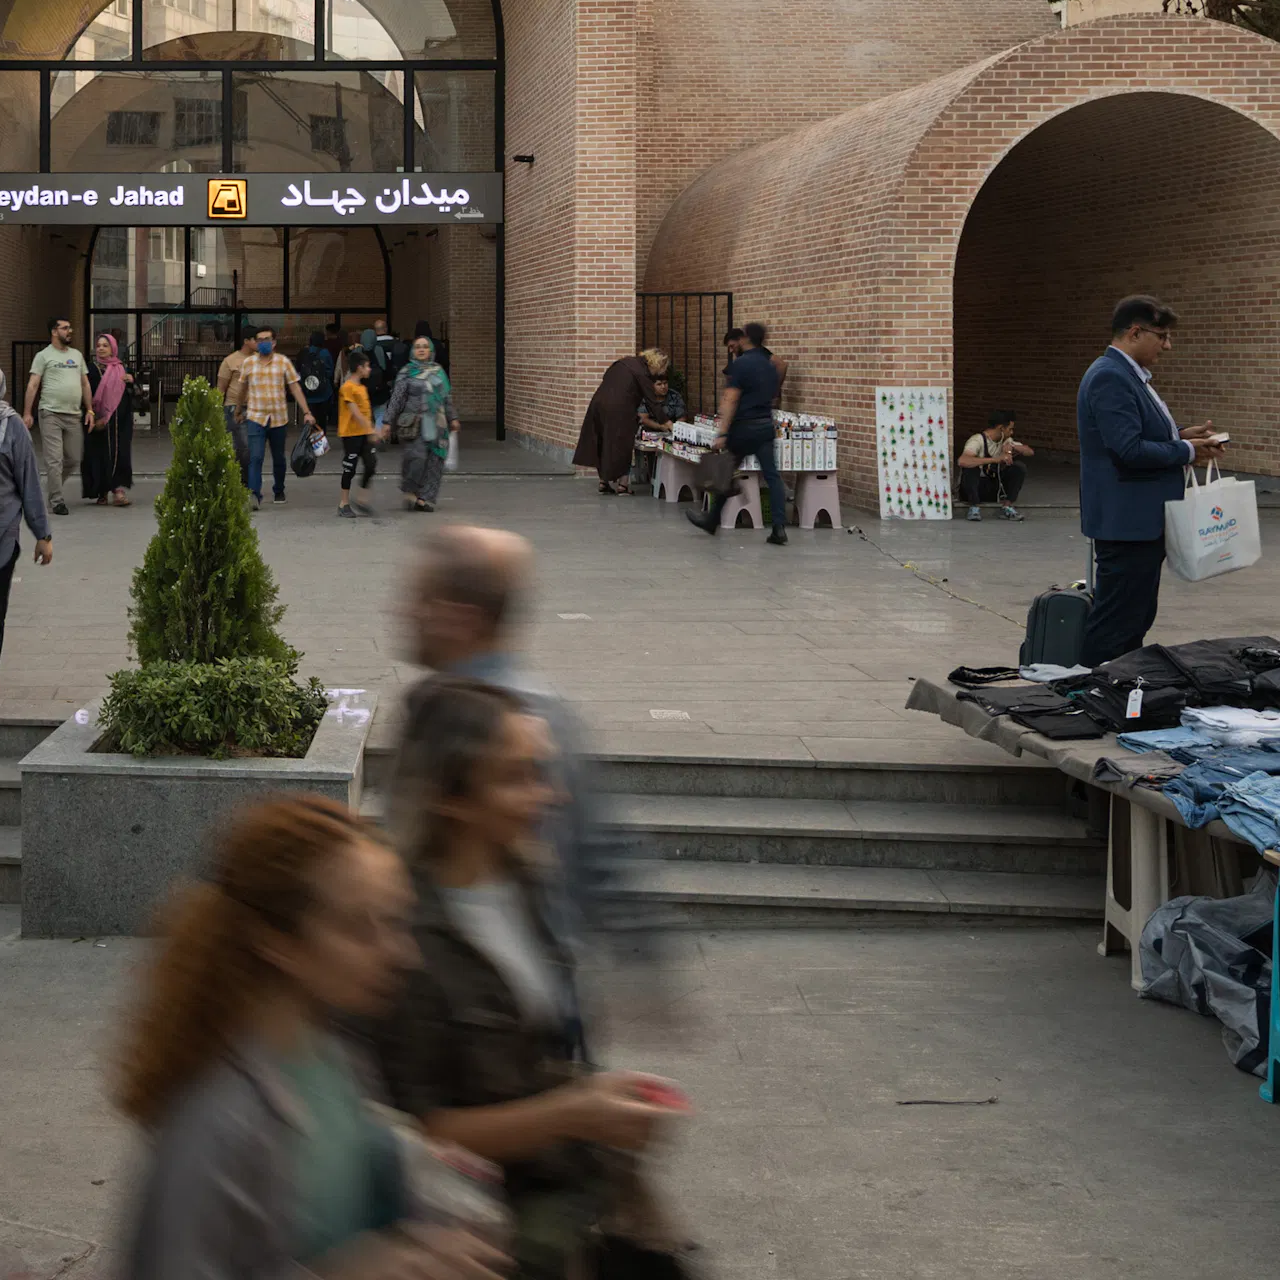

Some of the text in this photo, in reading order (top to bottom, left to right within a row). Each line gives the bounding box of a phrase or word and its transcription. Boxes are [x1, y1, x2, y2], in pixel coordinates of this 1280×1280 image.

[109, 185, 184, 206] Jahad
[280, 178, 470, 216] میدان جهاد
